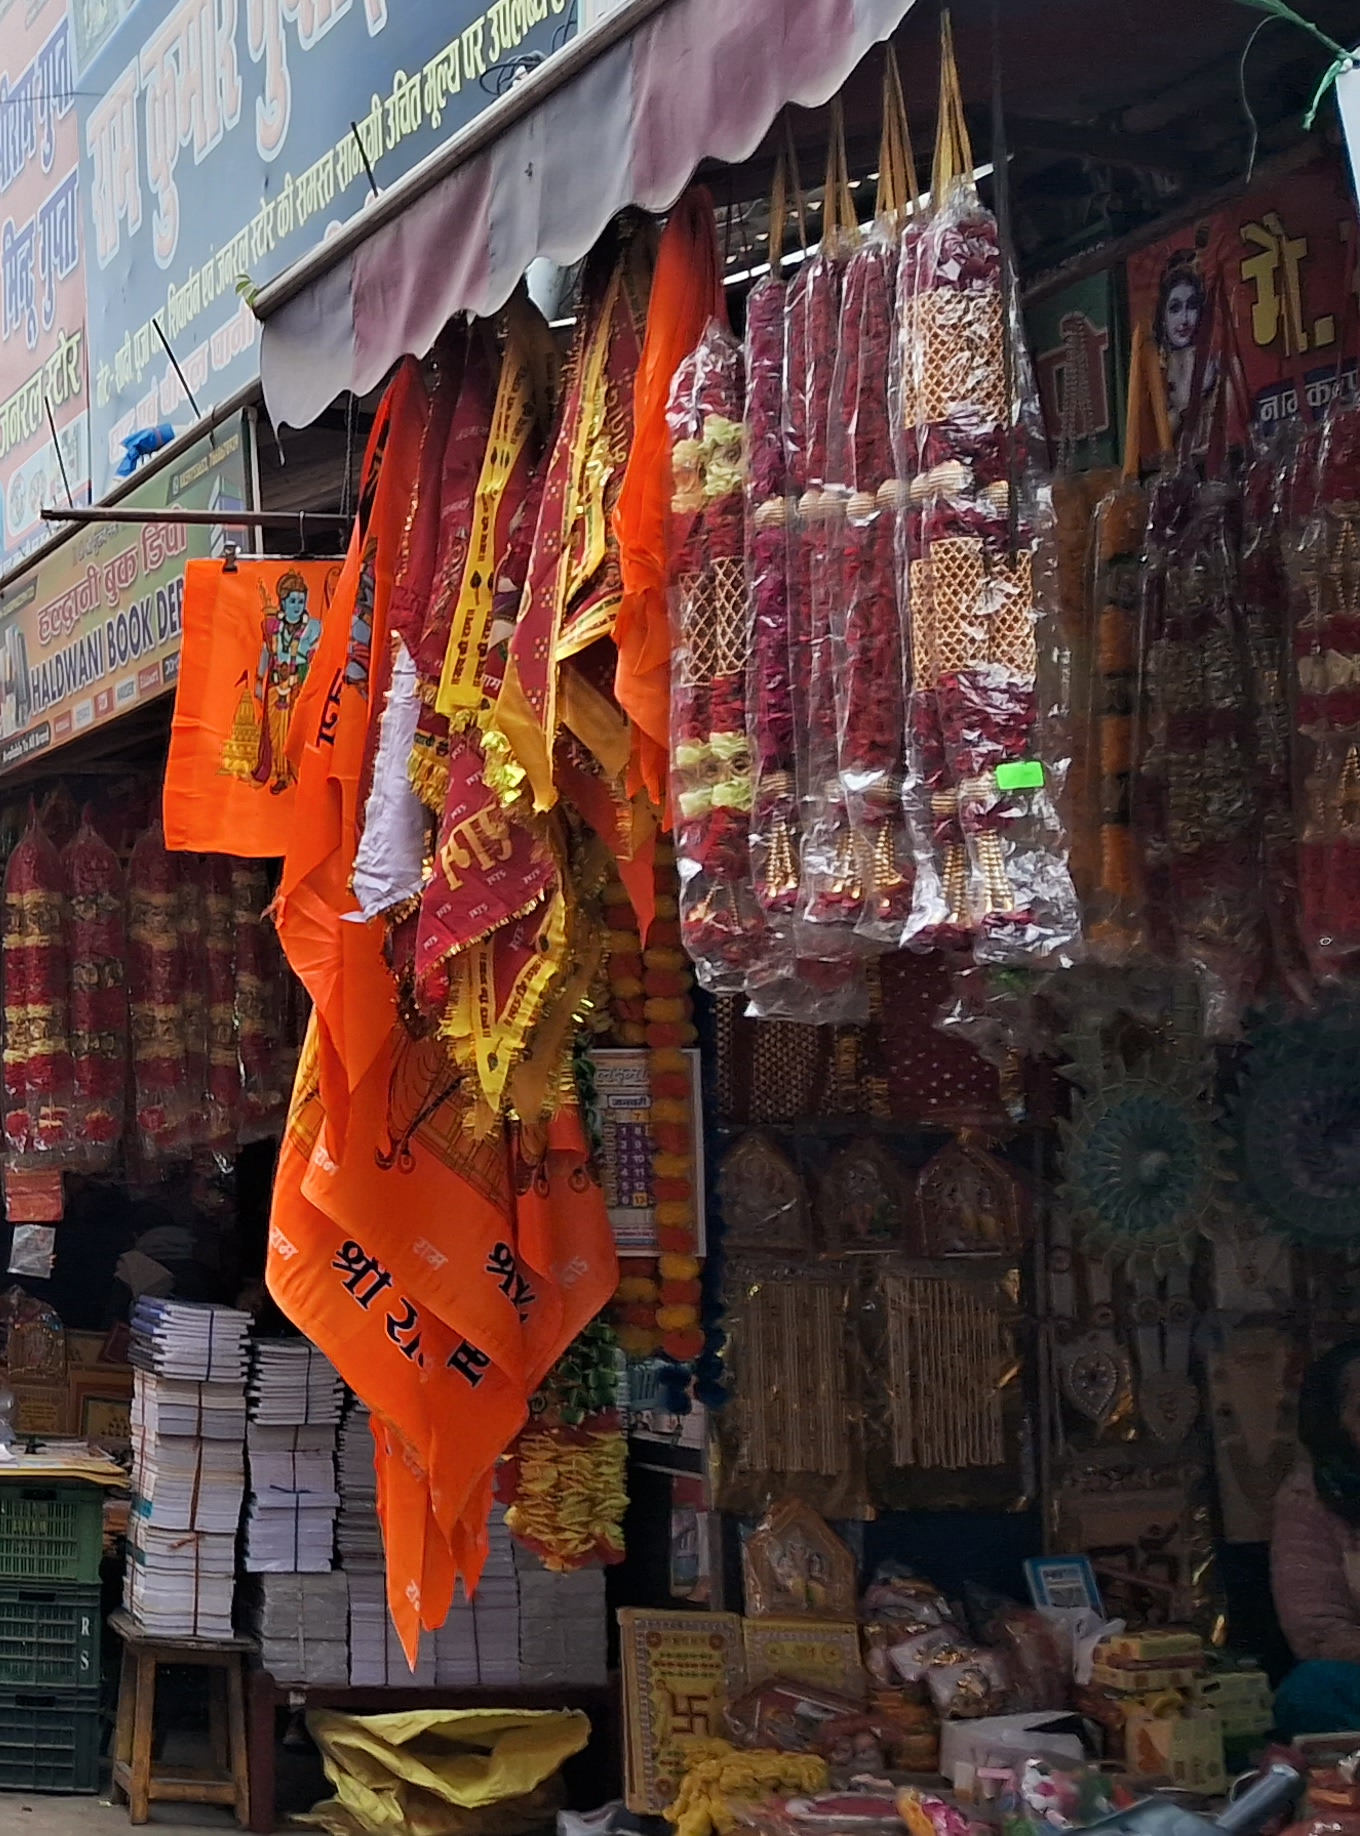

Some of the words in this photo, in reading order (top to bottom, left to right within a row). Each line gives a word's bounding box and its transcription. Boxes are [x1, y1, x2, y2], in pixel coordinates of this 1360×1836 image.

[216, 227, 248, 290] जनरल
[249, 198, 275, 264] स्टोर
[276, 172, 294, 237] की
[295, 148, 334, 226] समस्त
[384, 69, 423, 150] उचित
[422, 39, 461, 130] मूल्य
[461, 15, 486, 81] पर
[44, 328, 82, 406] स्टोर
[103, 544, 139, 608] बुक
[30, 627, 105, 716] HALDWANI
[106, 593, 155, 672] BOOK
[155, 573, 185, 645] DEP
